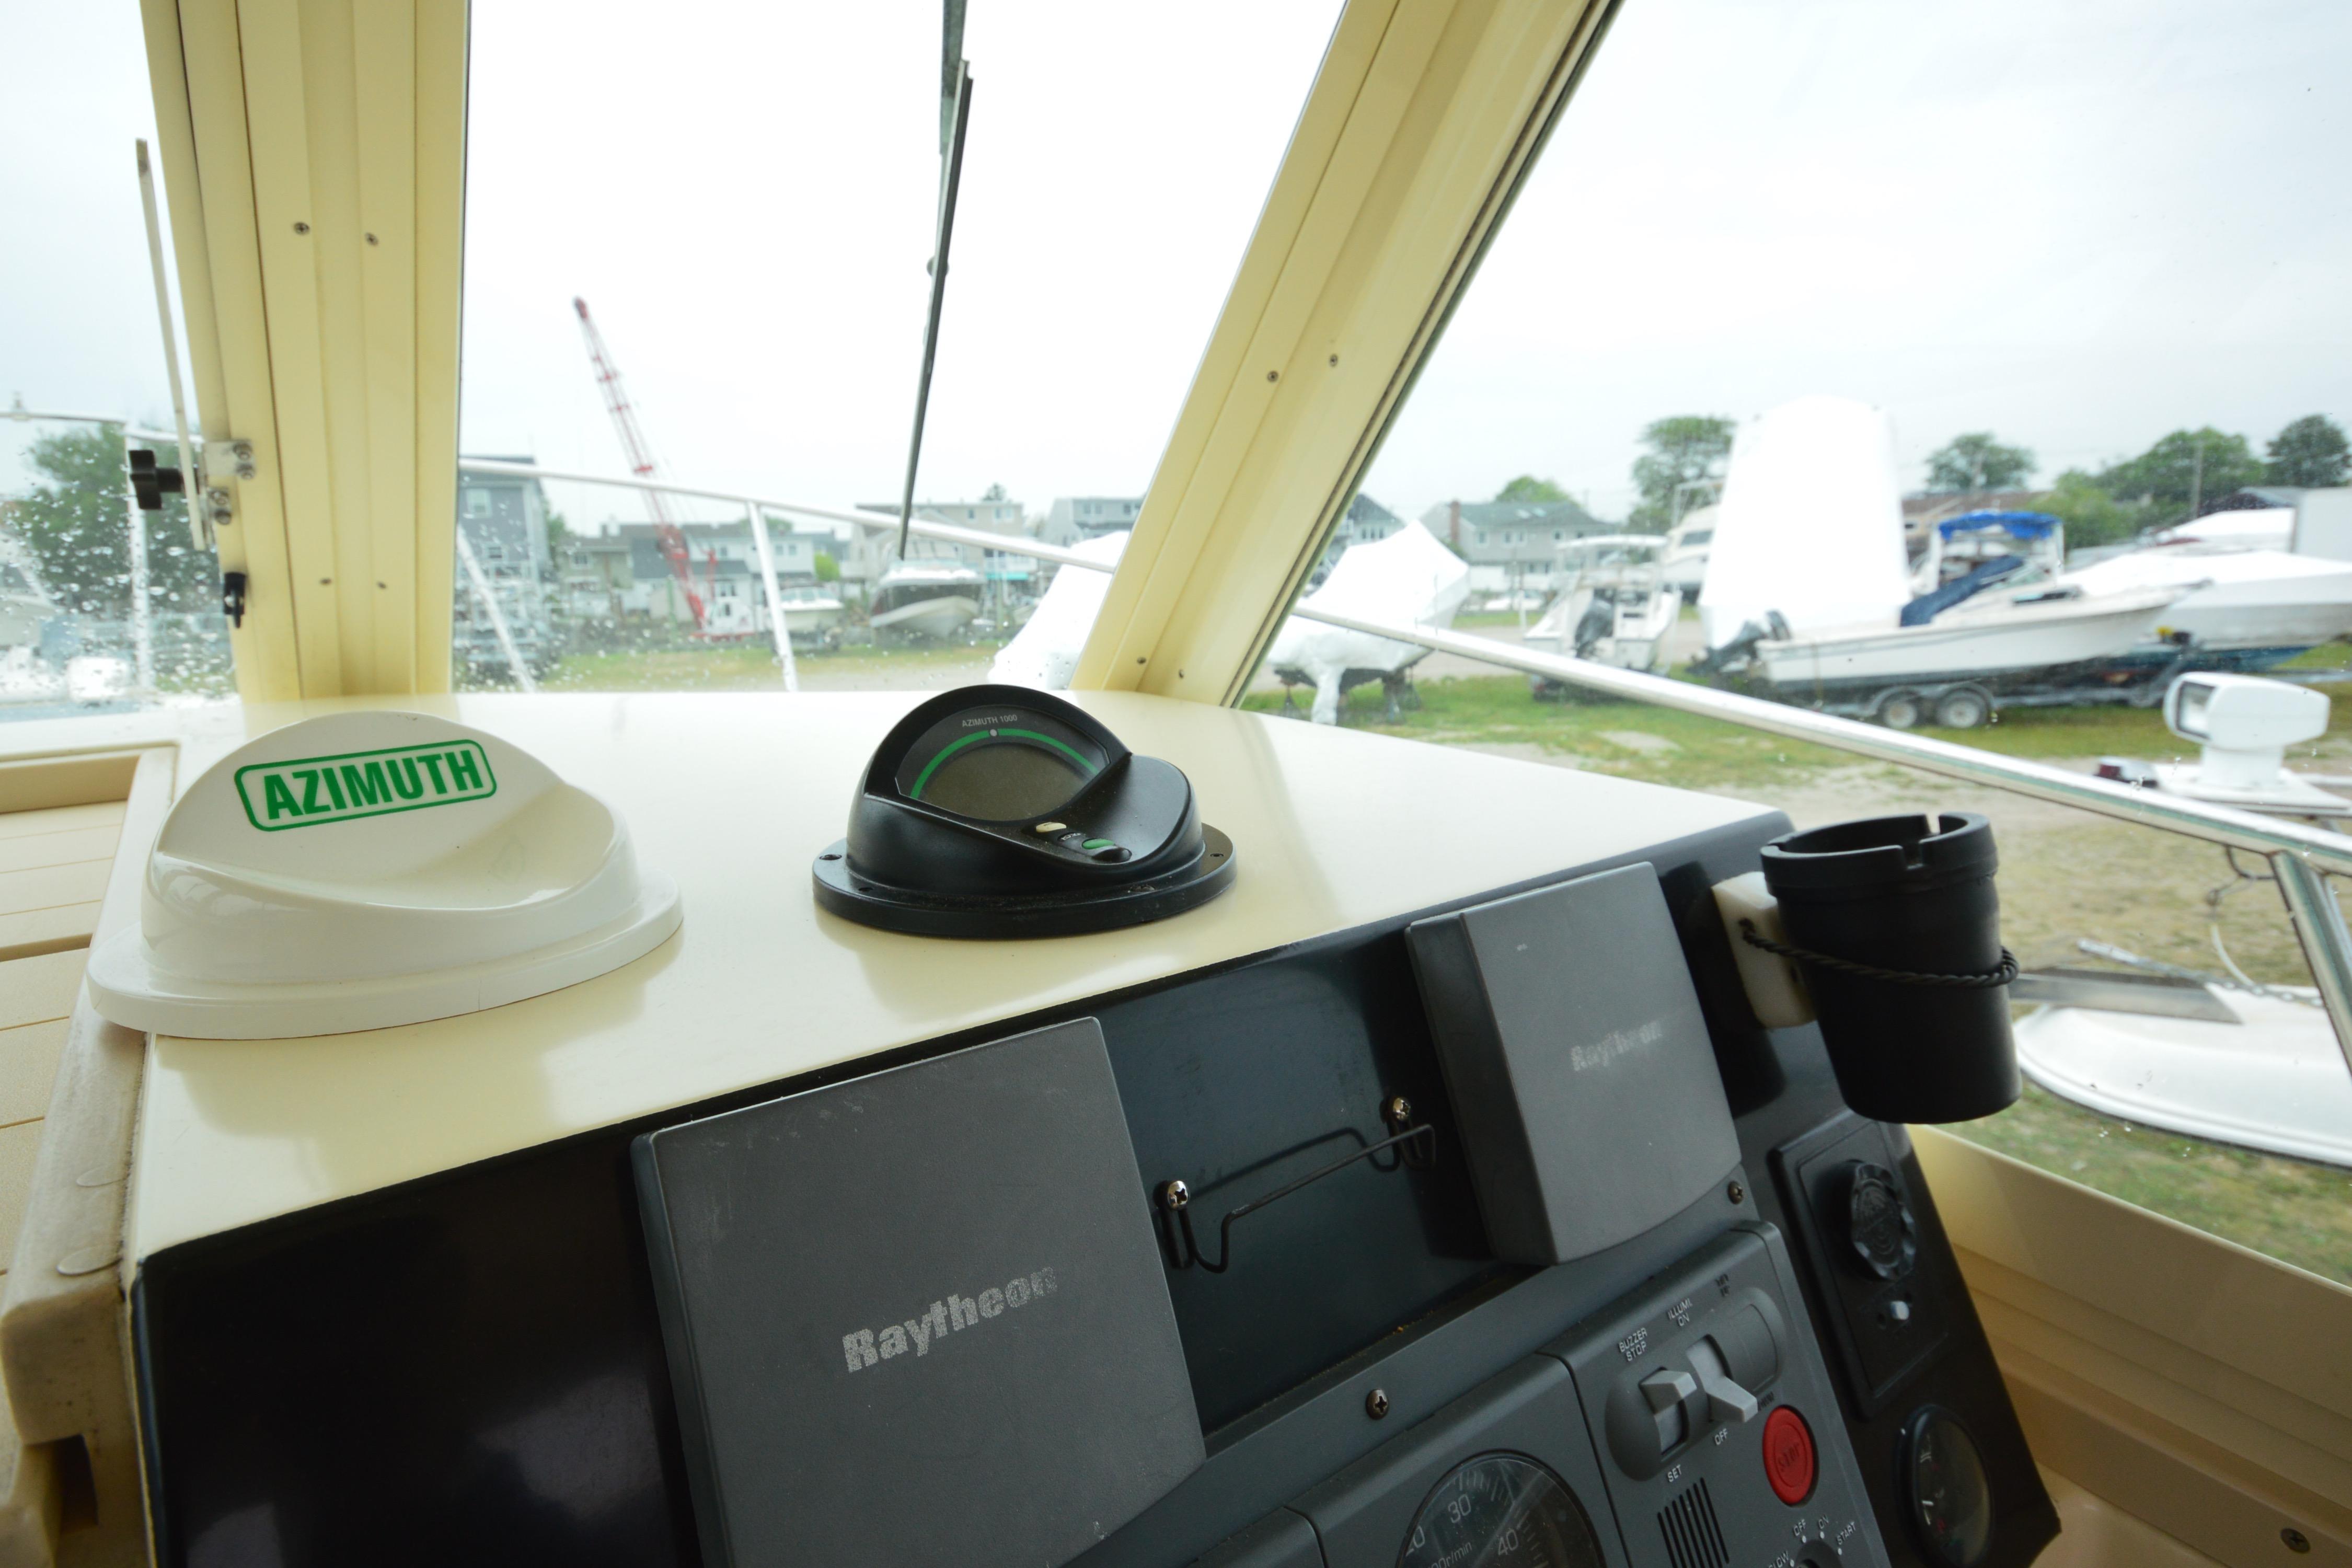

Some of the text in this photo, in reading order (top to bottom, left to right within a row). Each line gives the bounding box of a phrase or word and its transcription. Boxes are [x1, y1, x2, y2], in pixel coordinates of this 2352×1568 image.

[962, 716, 998, 727] AZIMUTH
[263, 750, 483, 820] AZIMUTH
[842, 1266, 1057, 1374] Raytheon
[1677, 1312, 1690, 1327] ON
[1618, 1327, 1647, 1353] BUZZER
[1626, 1341, 1647, 1362] STOP
[1714, 1428, 1728, 1445] OFF
[1667, 1464, 1682, 1482] SET
[1448, 1494, 1471, 1523] 30
[1793, 1519, 1806, 1536] OFF
[1818, 1515, 1829, 1529] ON
[1498, 1528, 1518, 1555] 40
[1836, 1521, 1857, 1545] START
